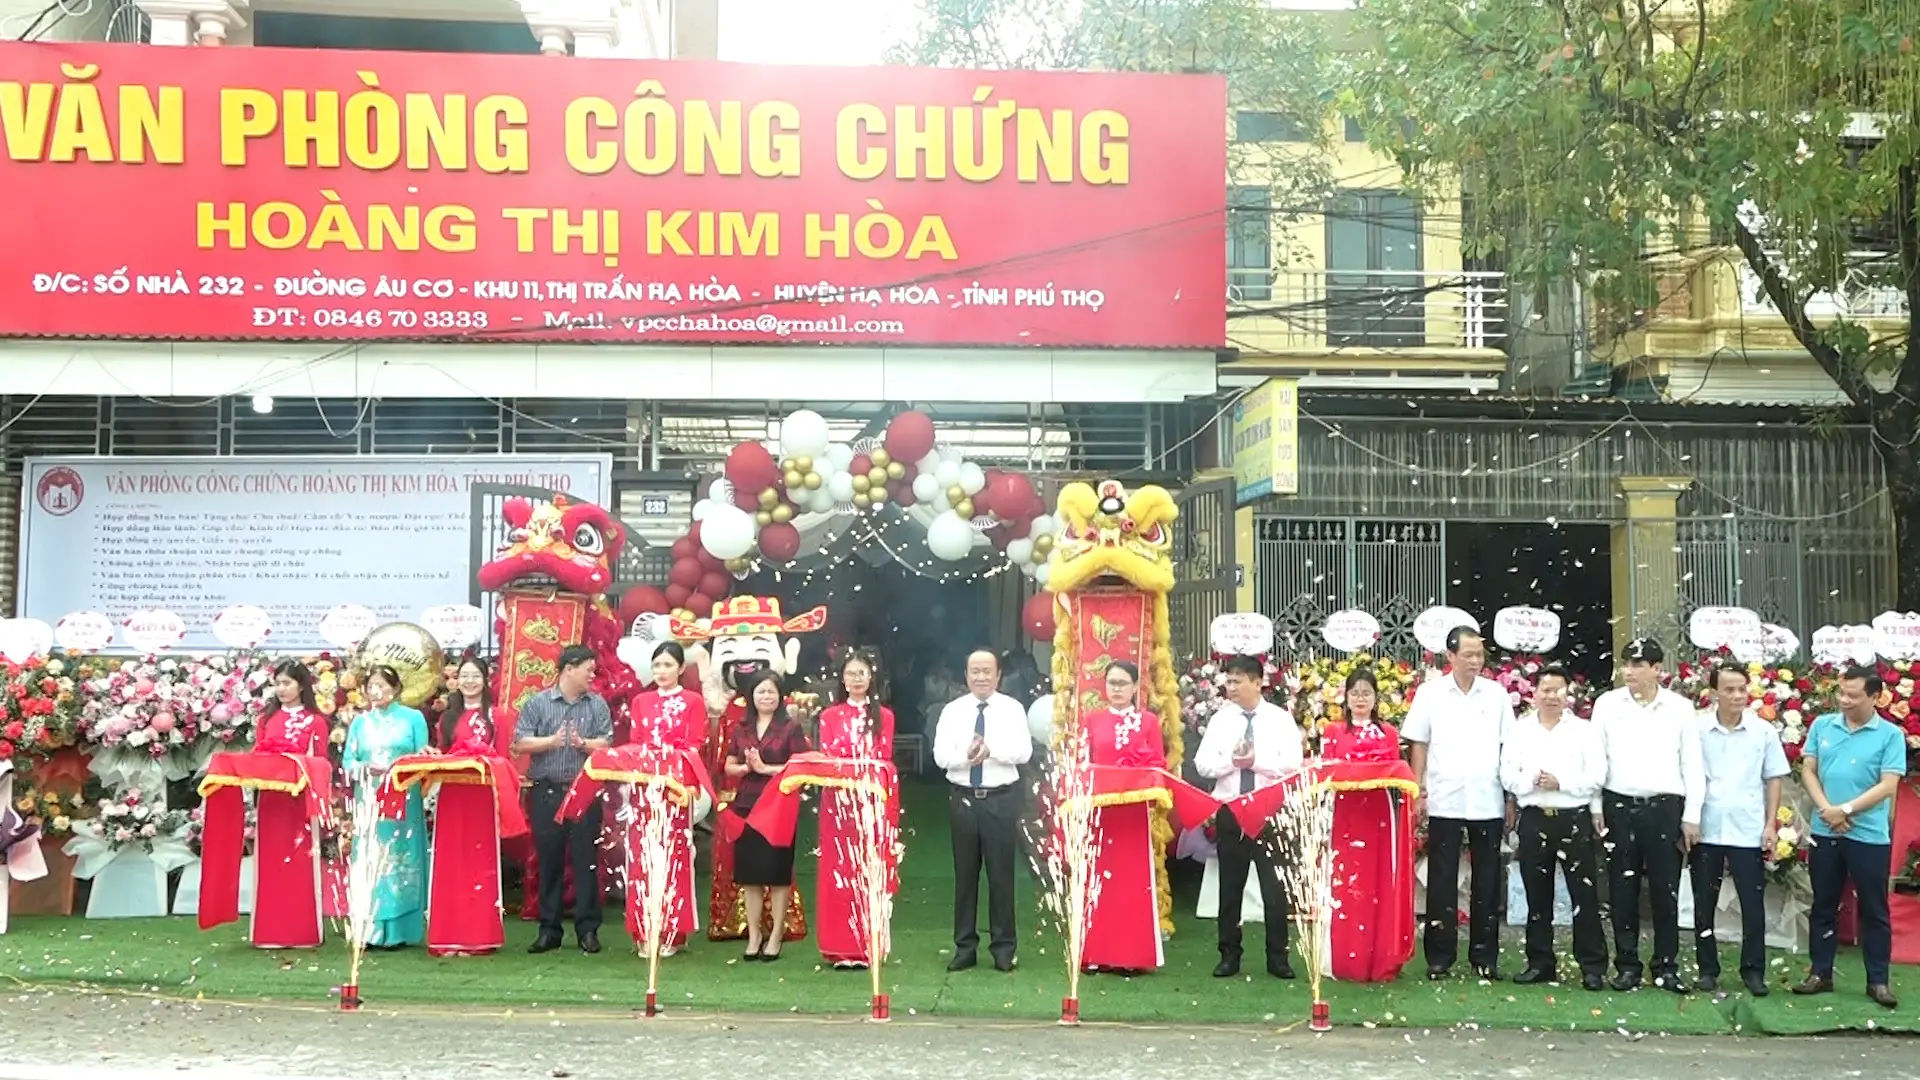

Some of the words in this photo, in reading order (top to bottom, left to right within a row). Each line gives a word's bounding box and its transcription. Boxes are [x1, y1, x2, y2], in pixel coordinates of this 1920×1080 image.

[0, 62, 185, 163] VĂN
[220, 70, 529, 173] PHÒNG
[565, 79, 800, 178] CÔNG
[836, 85, 1130, 185] CHỨNG
[197, 189, 477, 252] HOÀNG
[502, 208, 620, 267] THỊ
[646, 209, 780, 256] KIM
[804, 198, 959, 260] HÒA
[32, 271, 89, 294] Đ/C:
[93, 265, 130, 294] SỐ
[136, 269, 190, 295] NHÀ
[199, 277, 245, 296] 232
[274, 269, 367, 297] ĐƯỜNG
[374, 275, 407, 298] ÂU
[412, 279, 454, 299] CƠ
[474, 282, 519, 300] KHU
[547, 282, 578, 303] THỊ
[583, 273, 643, 300] TRẤN
[648, 282, 682, 305] HẠ
[689, 275, 742, 302] HÒA
[774, 280, 845, 307] HUYỆN
[850, 286, 883, 307] HẠ
[890, 283, 940, 304] HÒA
[962, 280, 1008, 305] TỈNH
[1015, 281, 1055, 306] PHÚ
[1060, 289, 1105, 312] THỌ
[252, 307, 306, 327] ĐT:
[313, 308, 383, 328] 0846
[388, 310, 417, 328] 70
[423, 310, 488, 329] 3333
[620, 313, 904, 336] vpcchahoa@gmail.com
[106, 471, 138, 493] VĂN
[140, 470, 193, 493] PHÒNG
[196, 469, 239, 493] CÔNG
[244, 470, 298, 493] CHỨNG
[302, 469, 358, 493] HOÀNG
[361, 474, 386, 497] THỊ
[391, 474, 422, 492] KIM
[426, 469, 458, 492] HÒA
[645, 500, 667, 514] 232
